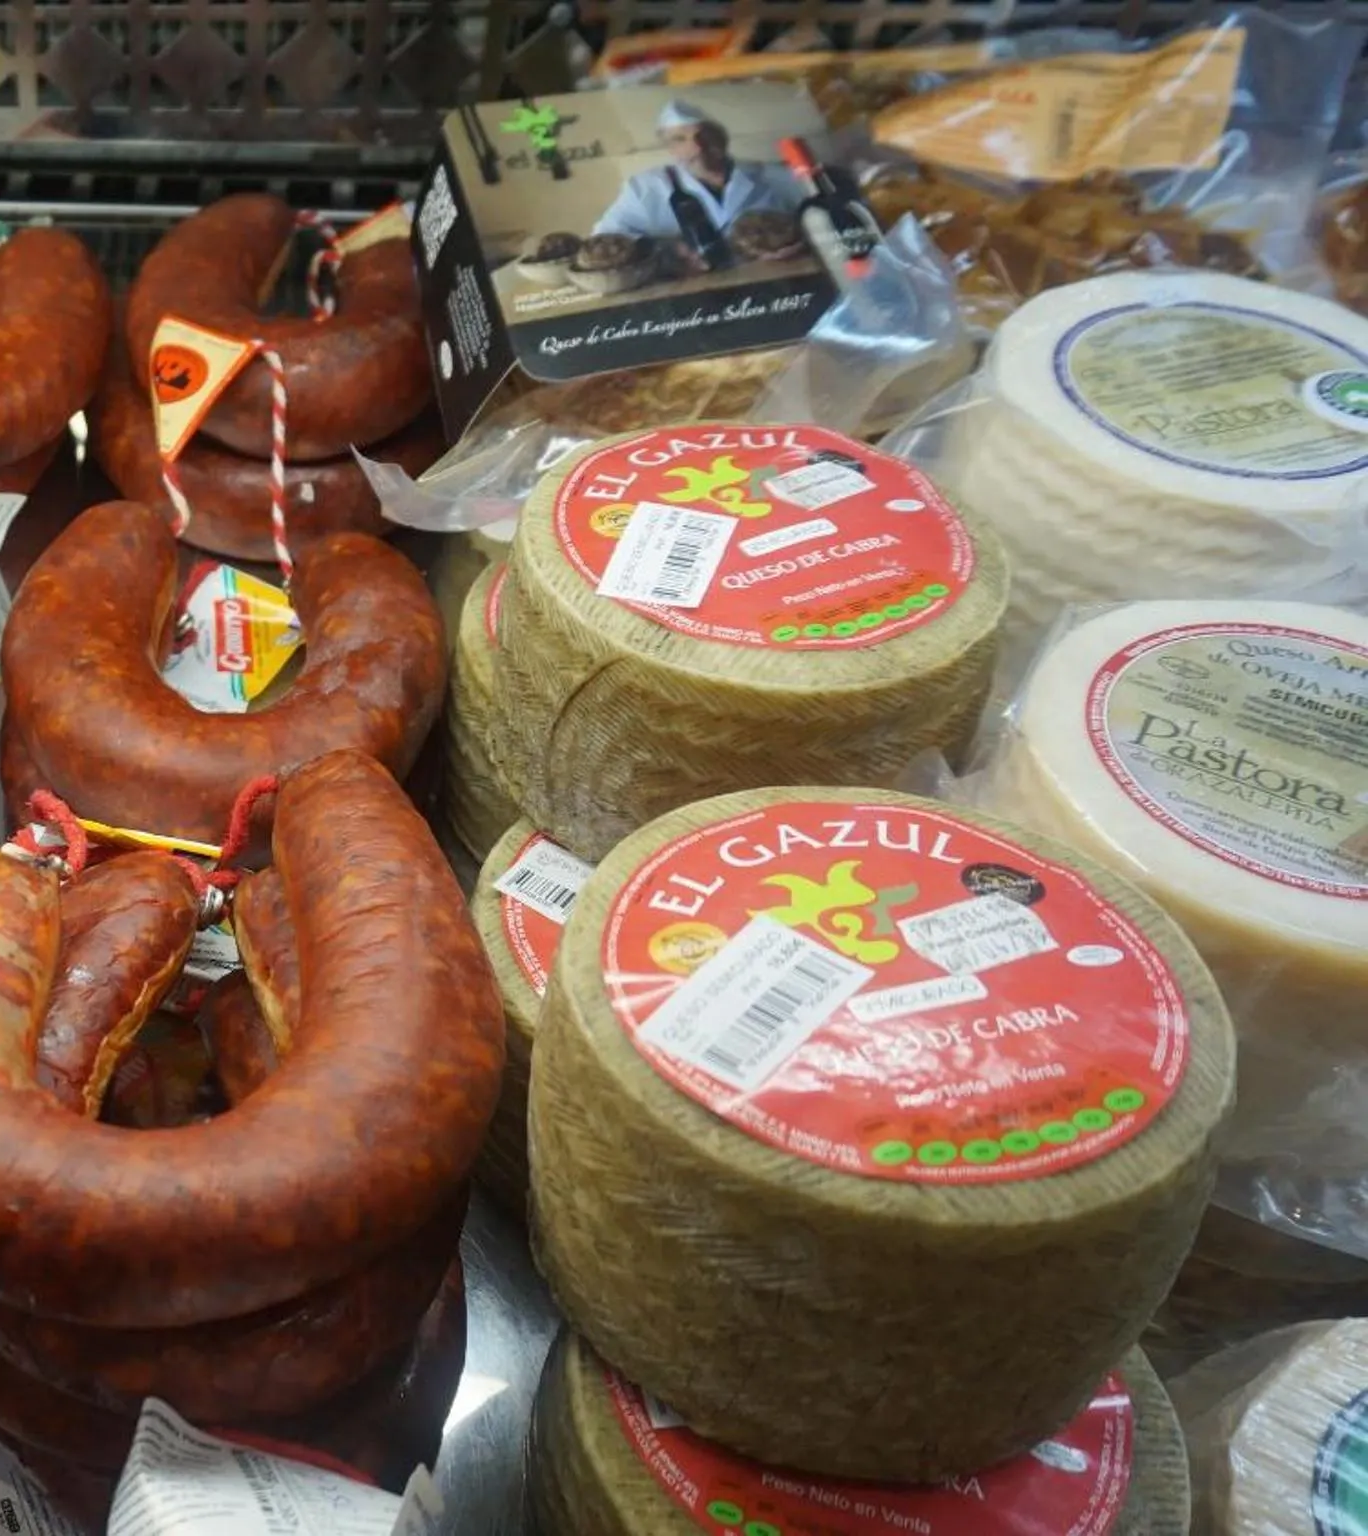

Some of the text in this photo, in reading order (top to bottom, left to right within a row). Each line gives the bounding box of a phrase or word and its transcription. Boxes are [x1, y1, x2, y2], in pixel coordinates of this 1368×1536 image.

[584, 430, 810, 501] EL GAZUL
[721, 559, 797, 590] QUESO
[798, 549, 831, 569] DE
[829, 533, 903, 559] CABRA
[1227, 639, 1316, 662] Queso
[1241, 661, 1322, 696] OVEJA
[1183, 719, 1227, 749] La
[1128, 710, 1351, 817] Pastora
[648, 819, 965, 917] EL GAZUL
[930, 1022, 972, 1051] DE
[973, 1002, 1081, 1039] CABRA
[1013, 1061, 1067, 1083] Venta
[761, 1472, 932, 1536] Peso Neto en Venta
